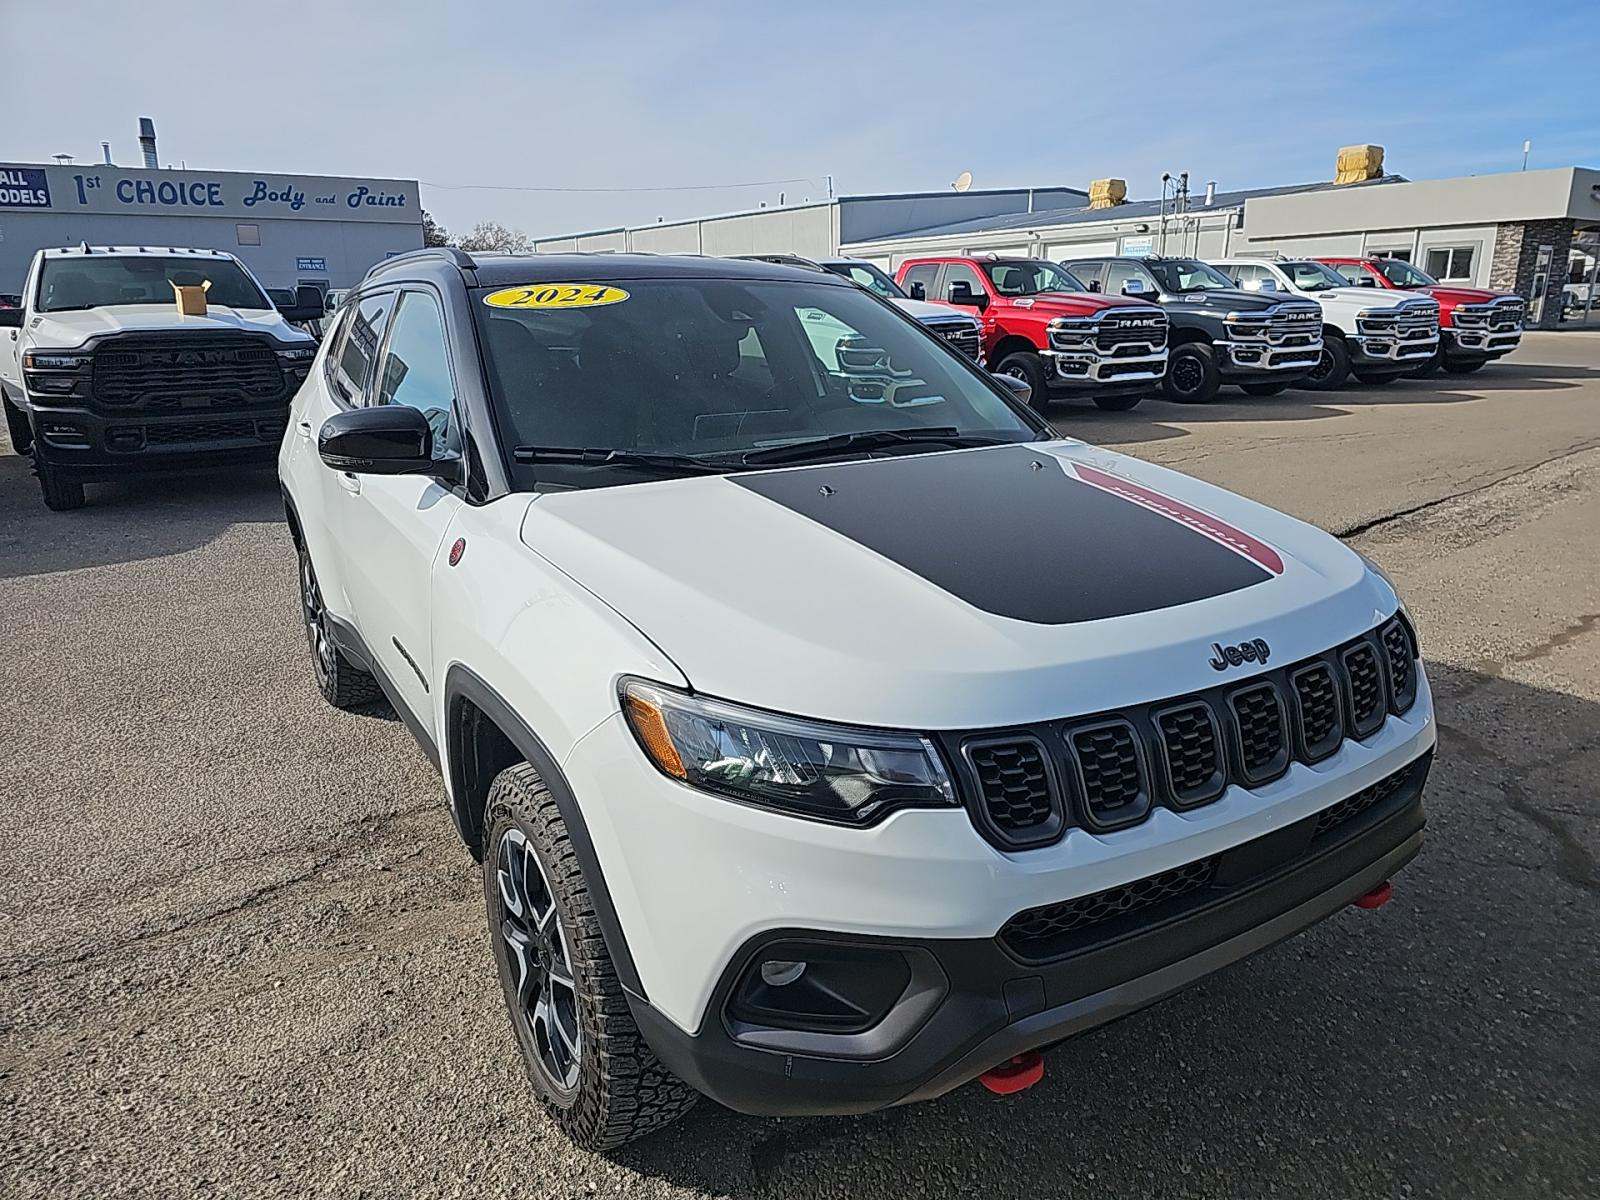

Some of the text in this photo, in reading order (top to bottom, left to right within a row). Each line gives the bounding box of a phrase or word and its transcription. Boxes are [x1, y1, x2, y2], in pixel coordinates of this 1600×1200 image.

[0, 189, 47, 204] ODELS
[73, 175, 405, 211] 1st CHOICE Body and Paint
[510, 288, 609, 305] 2024
[1120, 319, 1154, 327] RAM
[1208, 638, 1270, 671] Jeep
